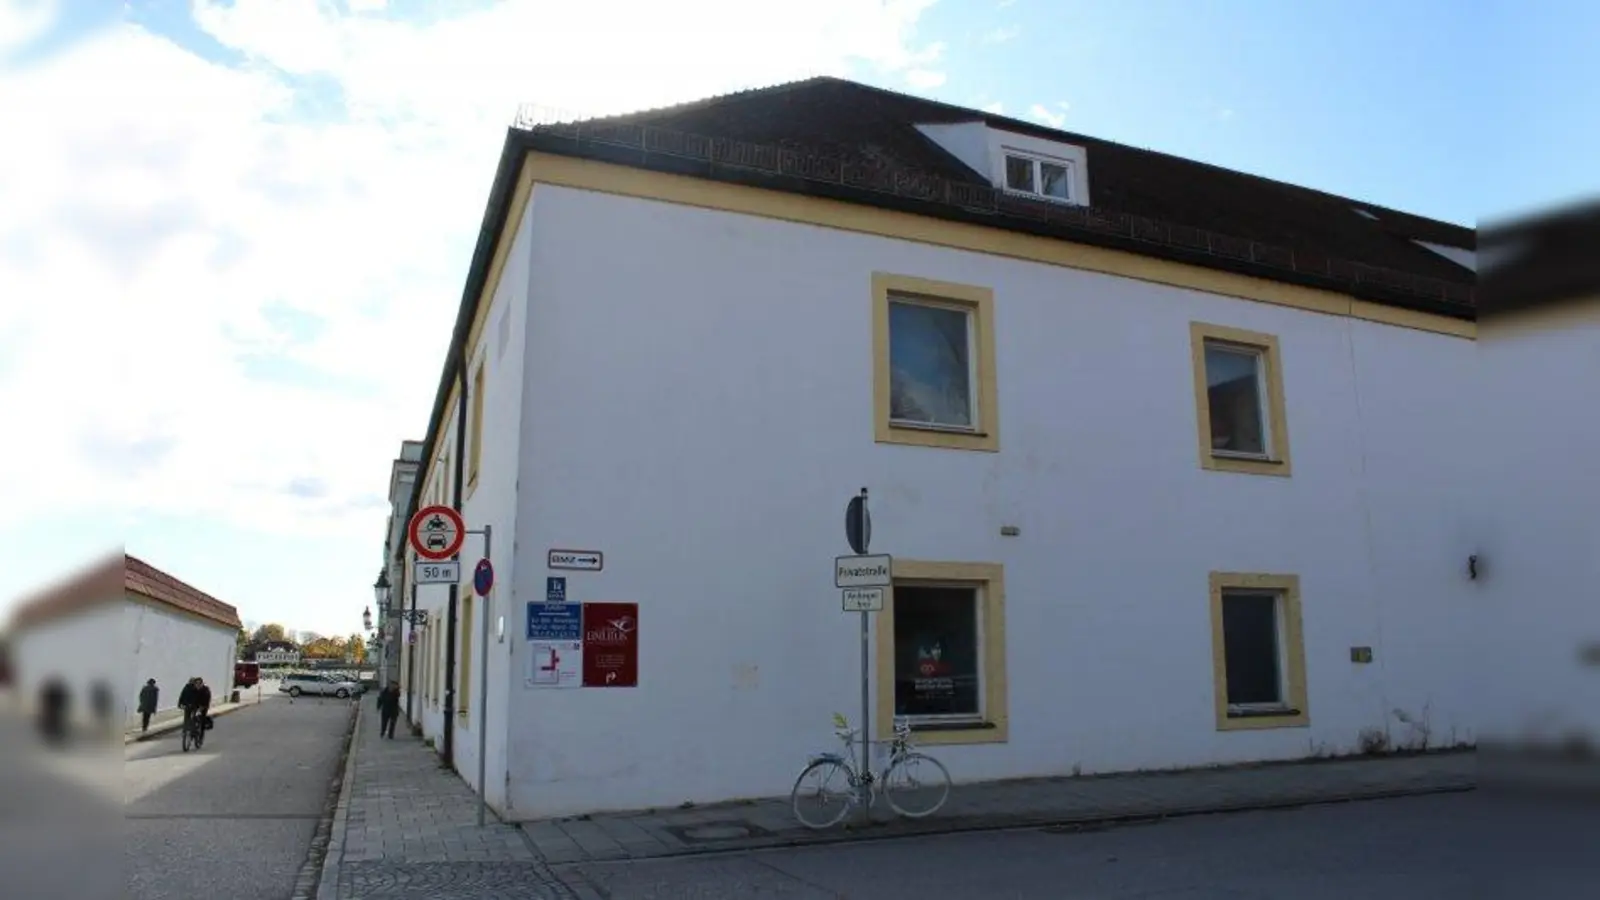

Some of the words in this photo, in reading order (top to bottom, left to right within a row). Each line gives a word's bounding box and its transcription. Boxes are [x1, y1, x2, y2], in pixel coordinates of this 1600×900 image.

[423, 566, 439, 578] 50
[442, 569, 452, 578] m
[838, 565, 888, 577] Privatstraße
